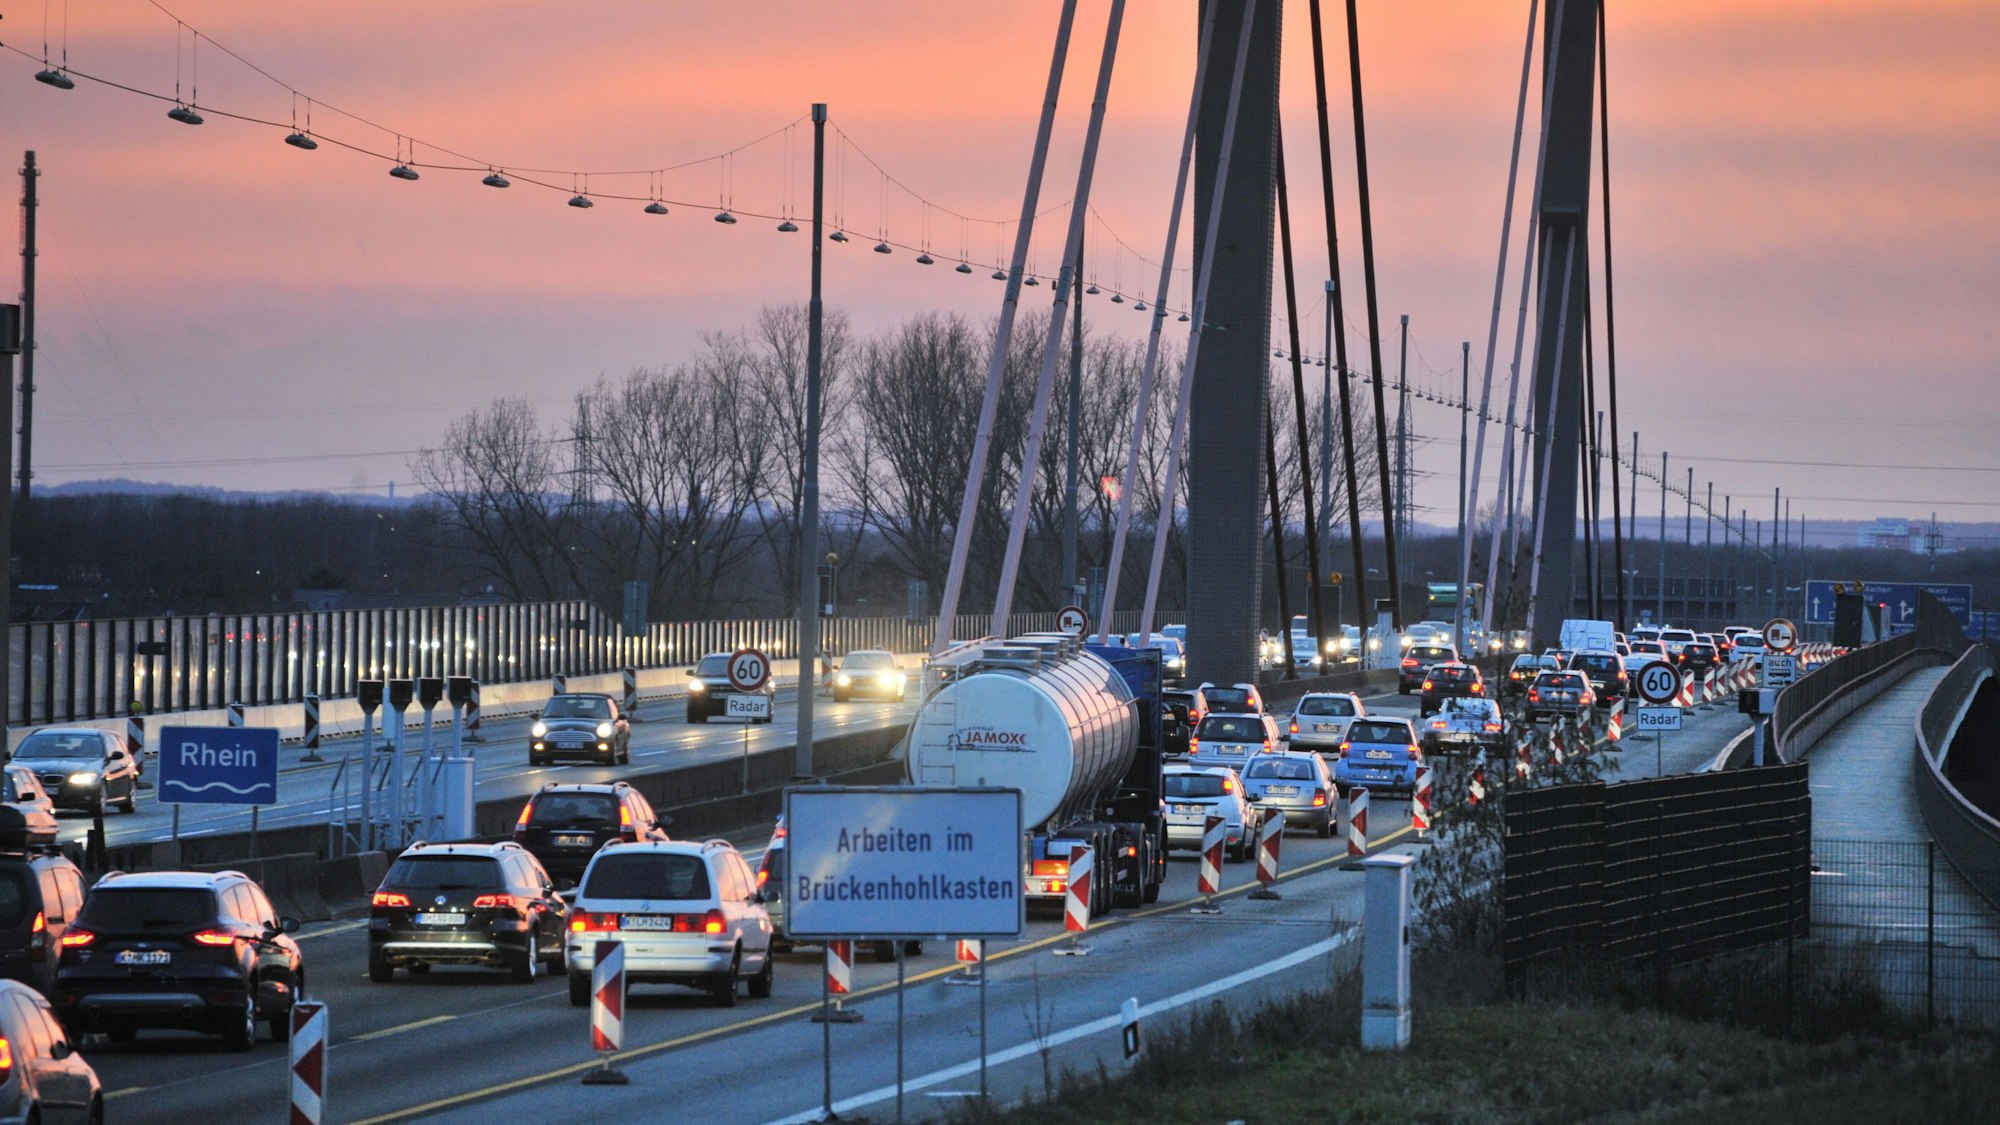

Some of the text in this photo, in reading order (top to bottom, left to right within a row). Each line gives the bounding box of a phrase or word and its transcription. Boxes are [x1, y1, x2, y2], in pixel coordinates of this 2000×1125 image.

[736, 660, 760, 680] 60
[1768, 658, 1792, 667] auch
[1646, 671, 1671, 692] 60
[729, 700, 766, 712] Radar
[1640, 713, 1678, 725] Radar
[180, 742, 257, 767] Rhein
[837, 826, 973, 853] Arbeiten im
[798, 875, 1013, 901] Brückenhohlkasten
[1113, 883, 1136, 893] AULT
